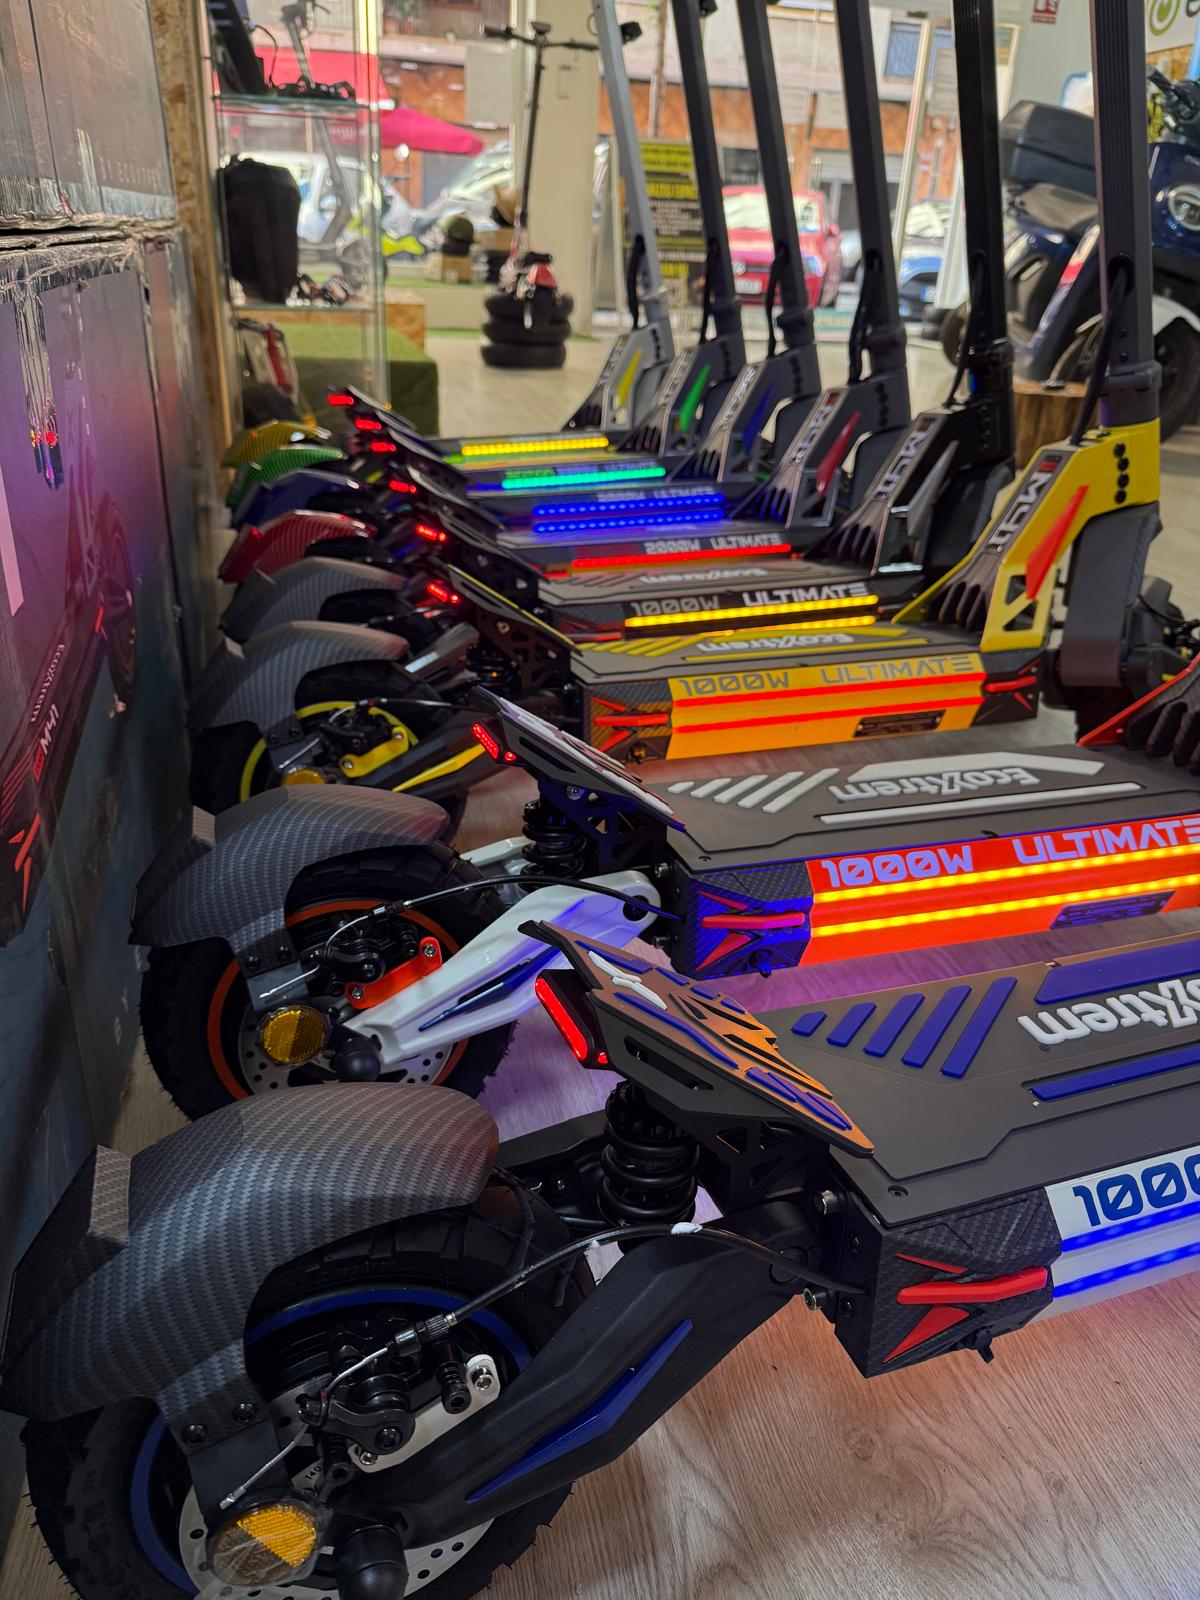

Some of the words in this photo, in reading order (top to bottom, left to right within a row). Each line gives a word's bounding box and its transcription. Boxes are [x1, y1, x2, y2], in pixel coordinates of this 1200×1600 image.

[989, 471, 1053, 545] M41
[710, 532, 783, 551] ULTIMATE
[630, 596, 719, 617] 1000W
[742, 582, 868, 607] ULTIMATE
[679, 671, 790, 696] 1000W
[820, 655, 976, 684] ULTIMATE
[40, 703, 59, 755] M41
[828, 766, 1041, 802] EcoXtrem
[821, 845, 974, 888] 1000W
[1012, 819, 1200, 865] ULTIMATE
[304, 1465, 322, 1480] 140
